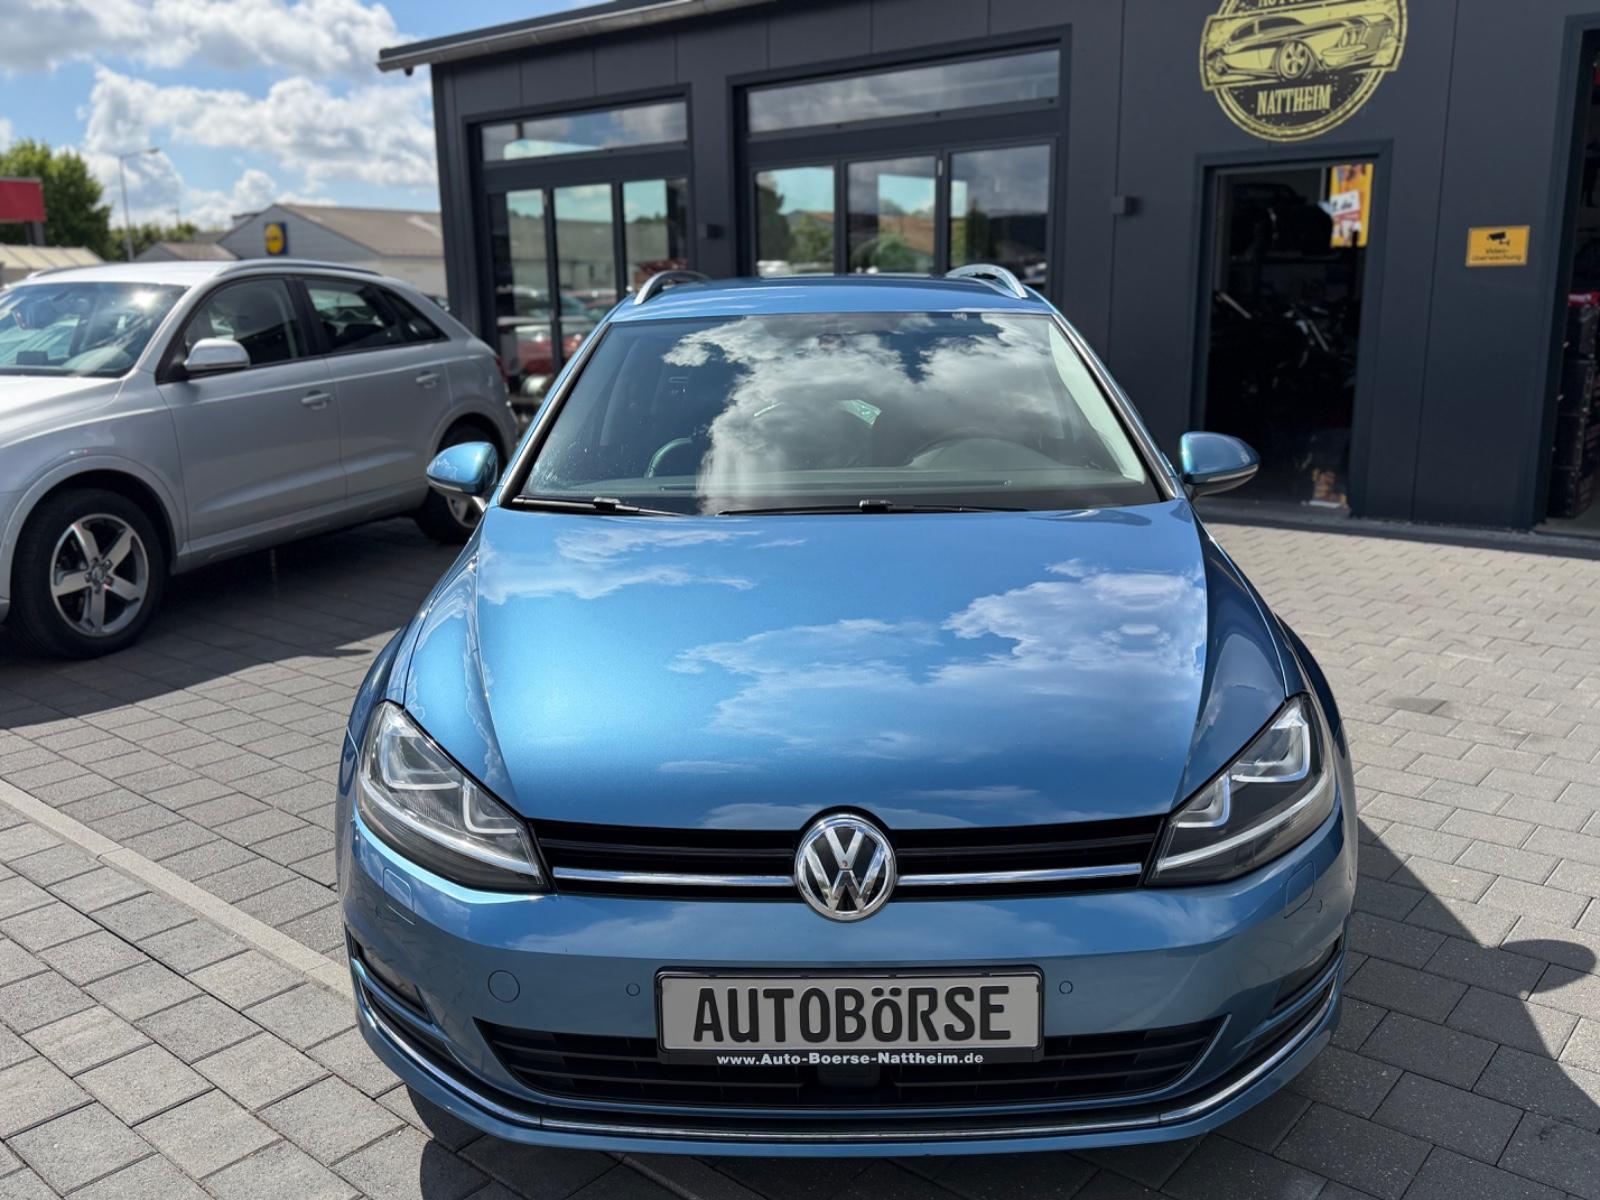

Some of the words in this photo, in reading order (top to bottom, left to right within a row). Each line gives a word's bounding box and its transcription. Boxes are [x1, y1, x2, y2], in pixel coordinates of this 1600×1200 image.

[1256, 84, 1332, 116] NATTHEIM
[799, 818, 891, 918] VW
[716, 1052, 984, 1065] www.Auto-Boerse-Nattheim.de
